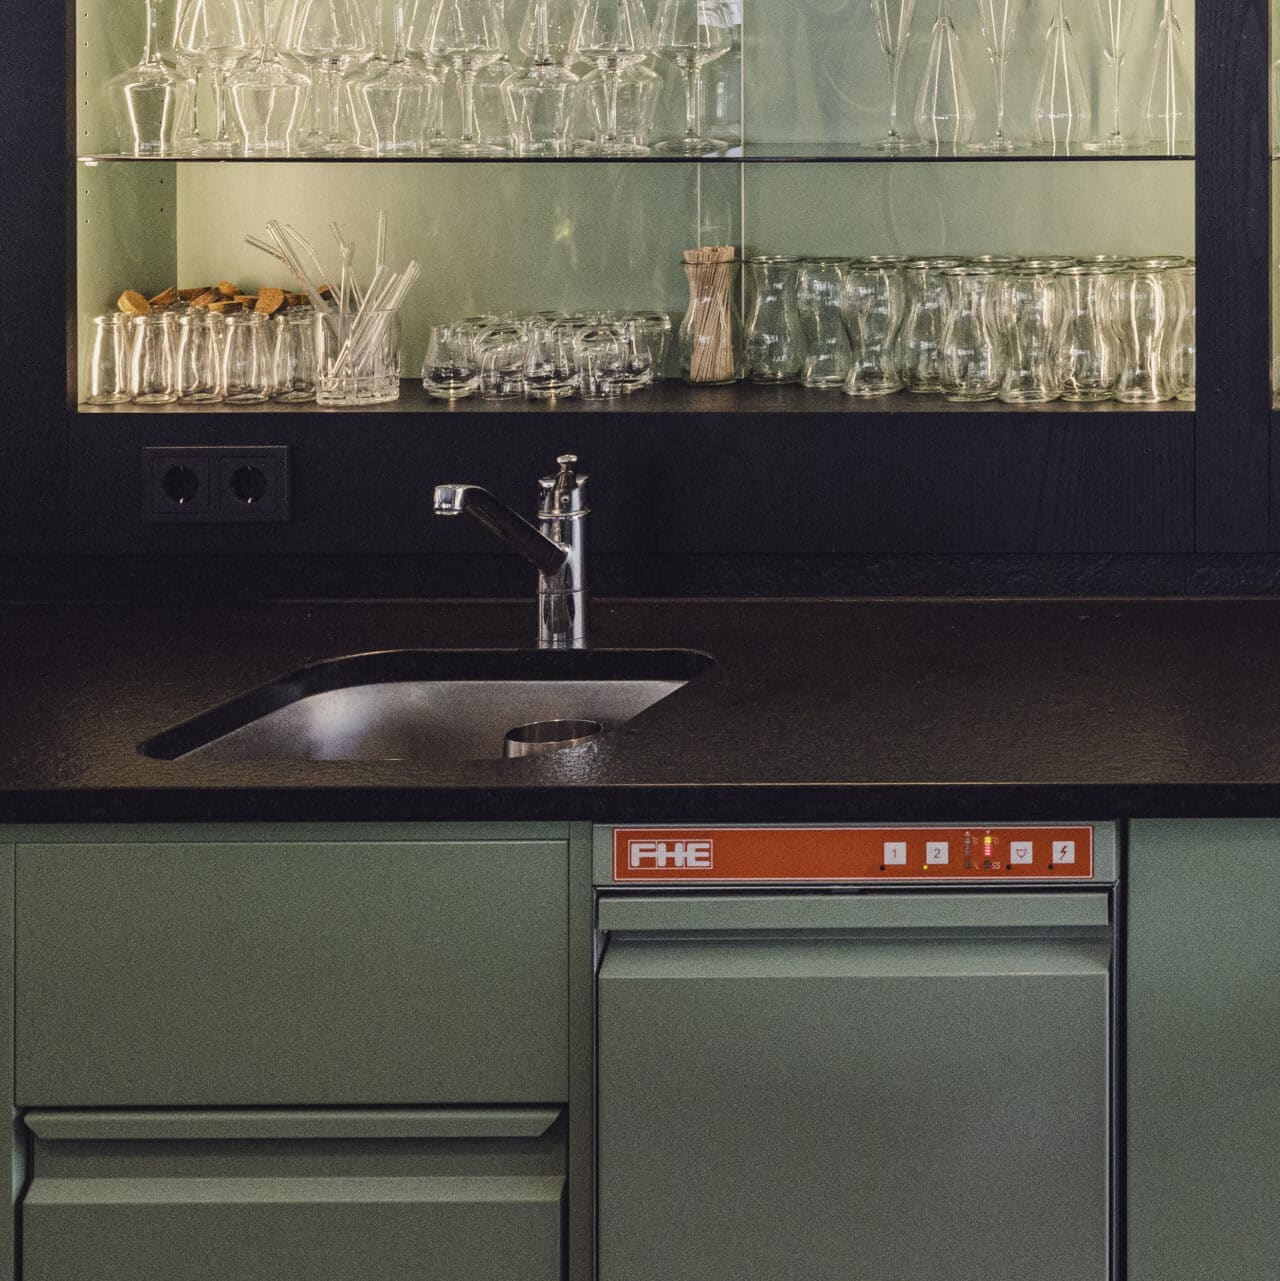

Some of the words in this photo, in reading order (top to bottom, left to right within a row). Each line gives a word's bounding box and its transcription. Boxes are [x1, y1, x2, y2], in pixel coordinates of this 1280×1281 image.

[630, 842, 711, 868] FHE
[892, 848, 897, 859] 1
[933, 848, 942, 859] 2
